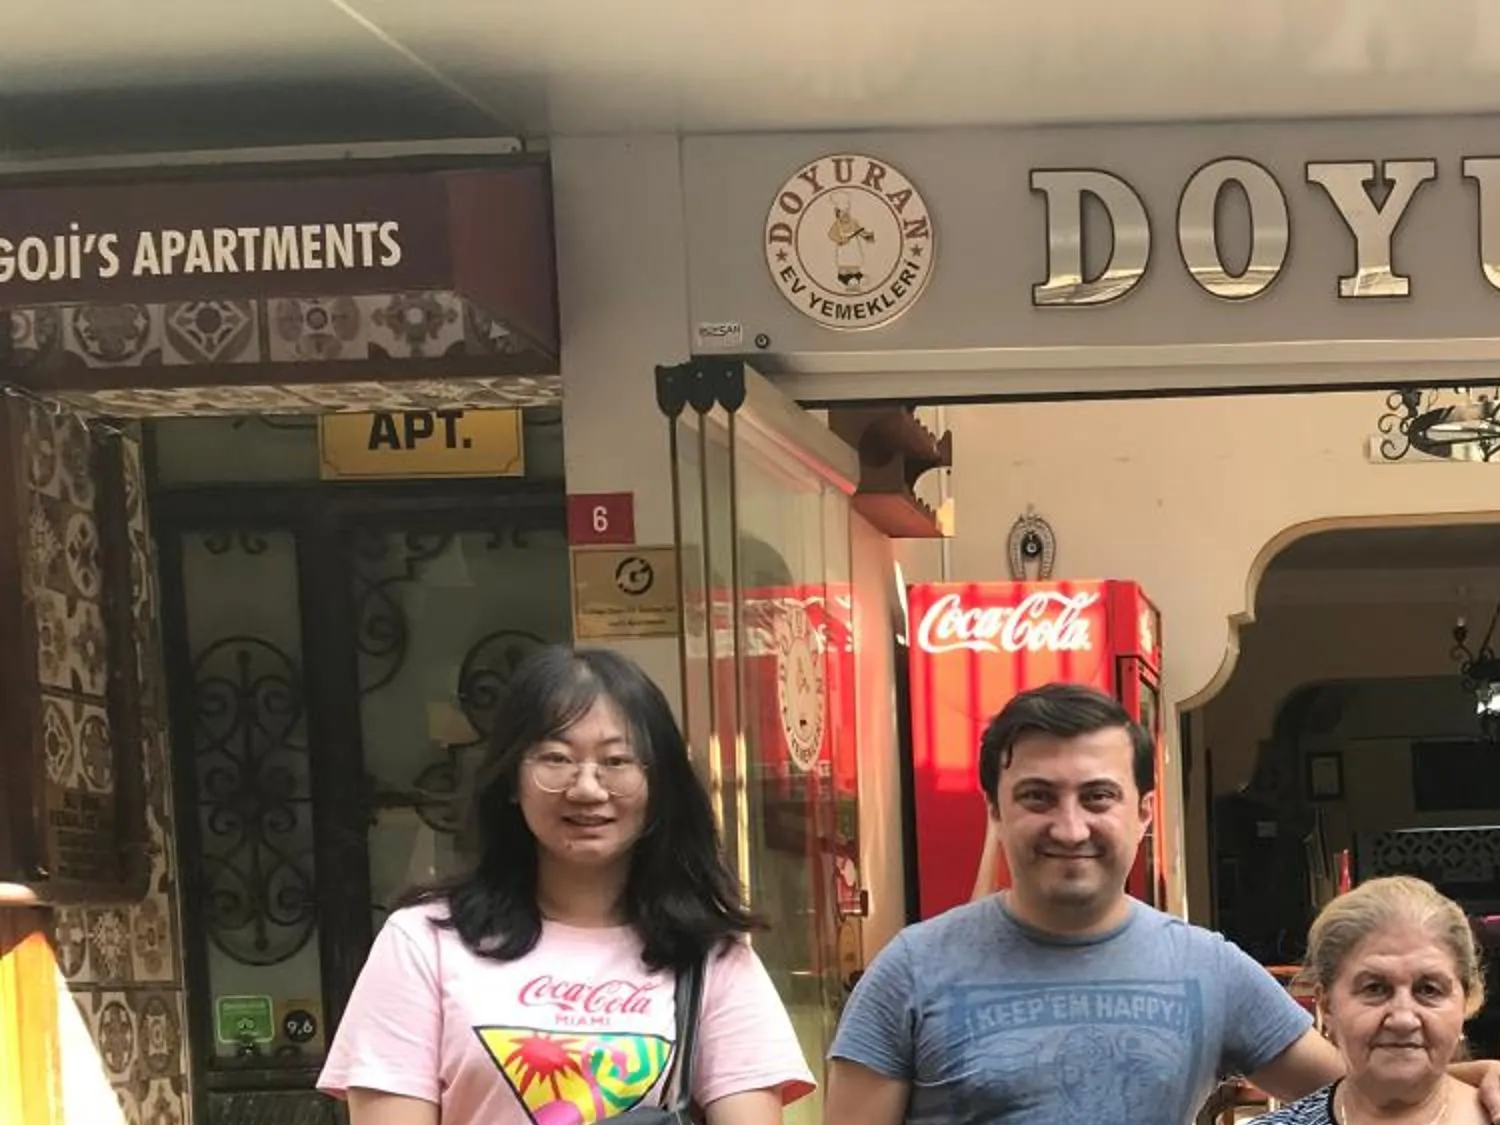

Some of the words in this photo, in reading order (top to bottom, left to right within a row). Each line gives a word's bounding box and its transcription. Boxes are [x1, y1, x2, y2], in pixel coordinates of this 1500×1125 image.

[769, 158, 929, 246] DOYURAN
[132, 221, 402, 277] APARTMENTS
[780, 265, 806, 295] EV
[808, 258, 922, 320] YEMEKLERİ
[368, 411, 473, 451] APT.
[592, 506, 609, 532] 6
[917, 591, 1101, 653] Coca-Cola
[517, 974, 662, 1015] Coca-Cola
[976, 998, 1044, 1032] KEEP
[555, 1015, 612, 1027] MIAMI
